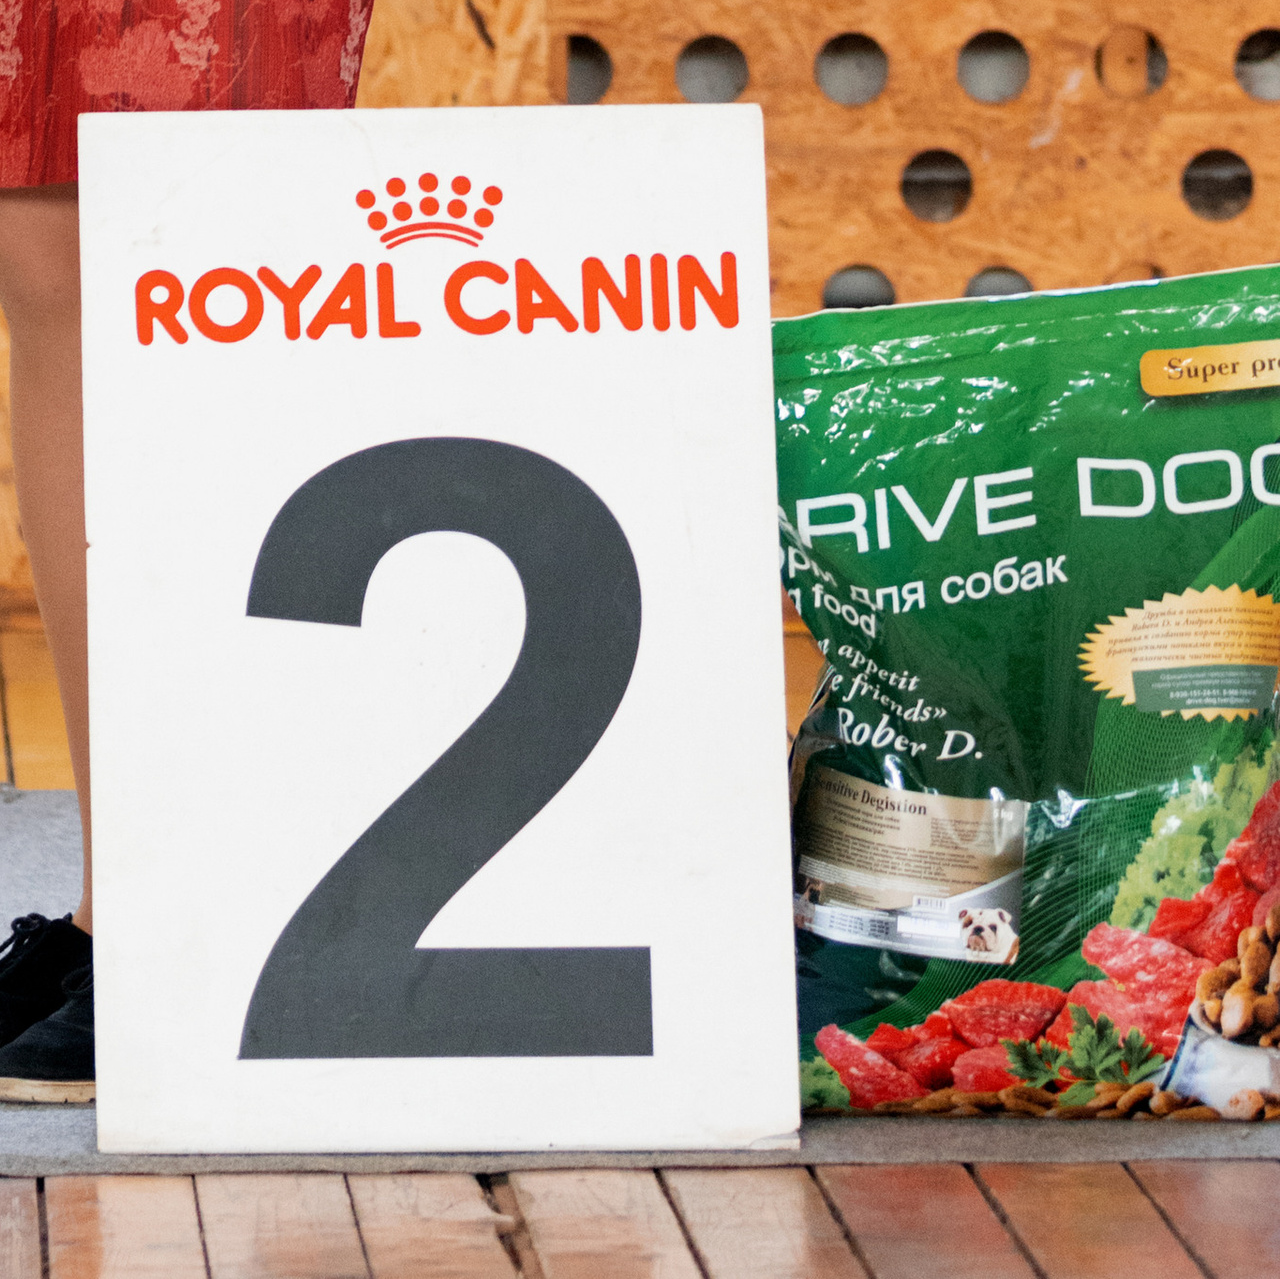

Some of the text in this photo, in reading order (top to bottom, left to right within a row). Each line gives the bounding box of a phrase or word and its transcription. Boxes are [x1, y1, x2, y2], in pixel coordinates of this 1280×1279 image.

[136, 250, 739, 346] ROYAL CANIN
[1167, 357, 1239, 383] Super
[782, 466, 1037, 553] RIVE
[812, 583, 877, 639] food
[850, 580, 926, 615] для
[940, 554, 1069, 604] собак
[838, 644, 920, 691] appetit
[842, 673, 947, 722] friends»
[239, 438, 653, 1059] 2
[837, 707, 983, 761] Rober D.
[814, 777, 859, 801] ensitive
